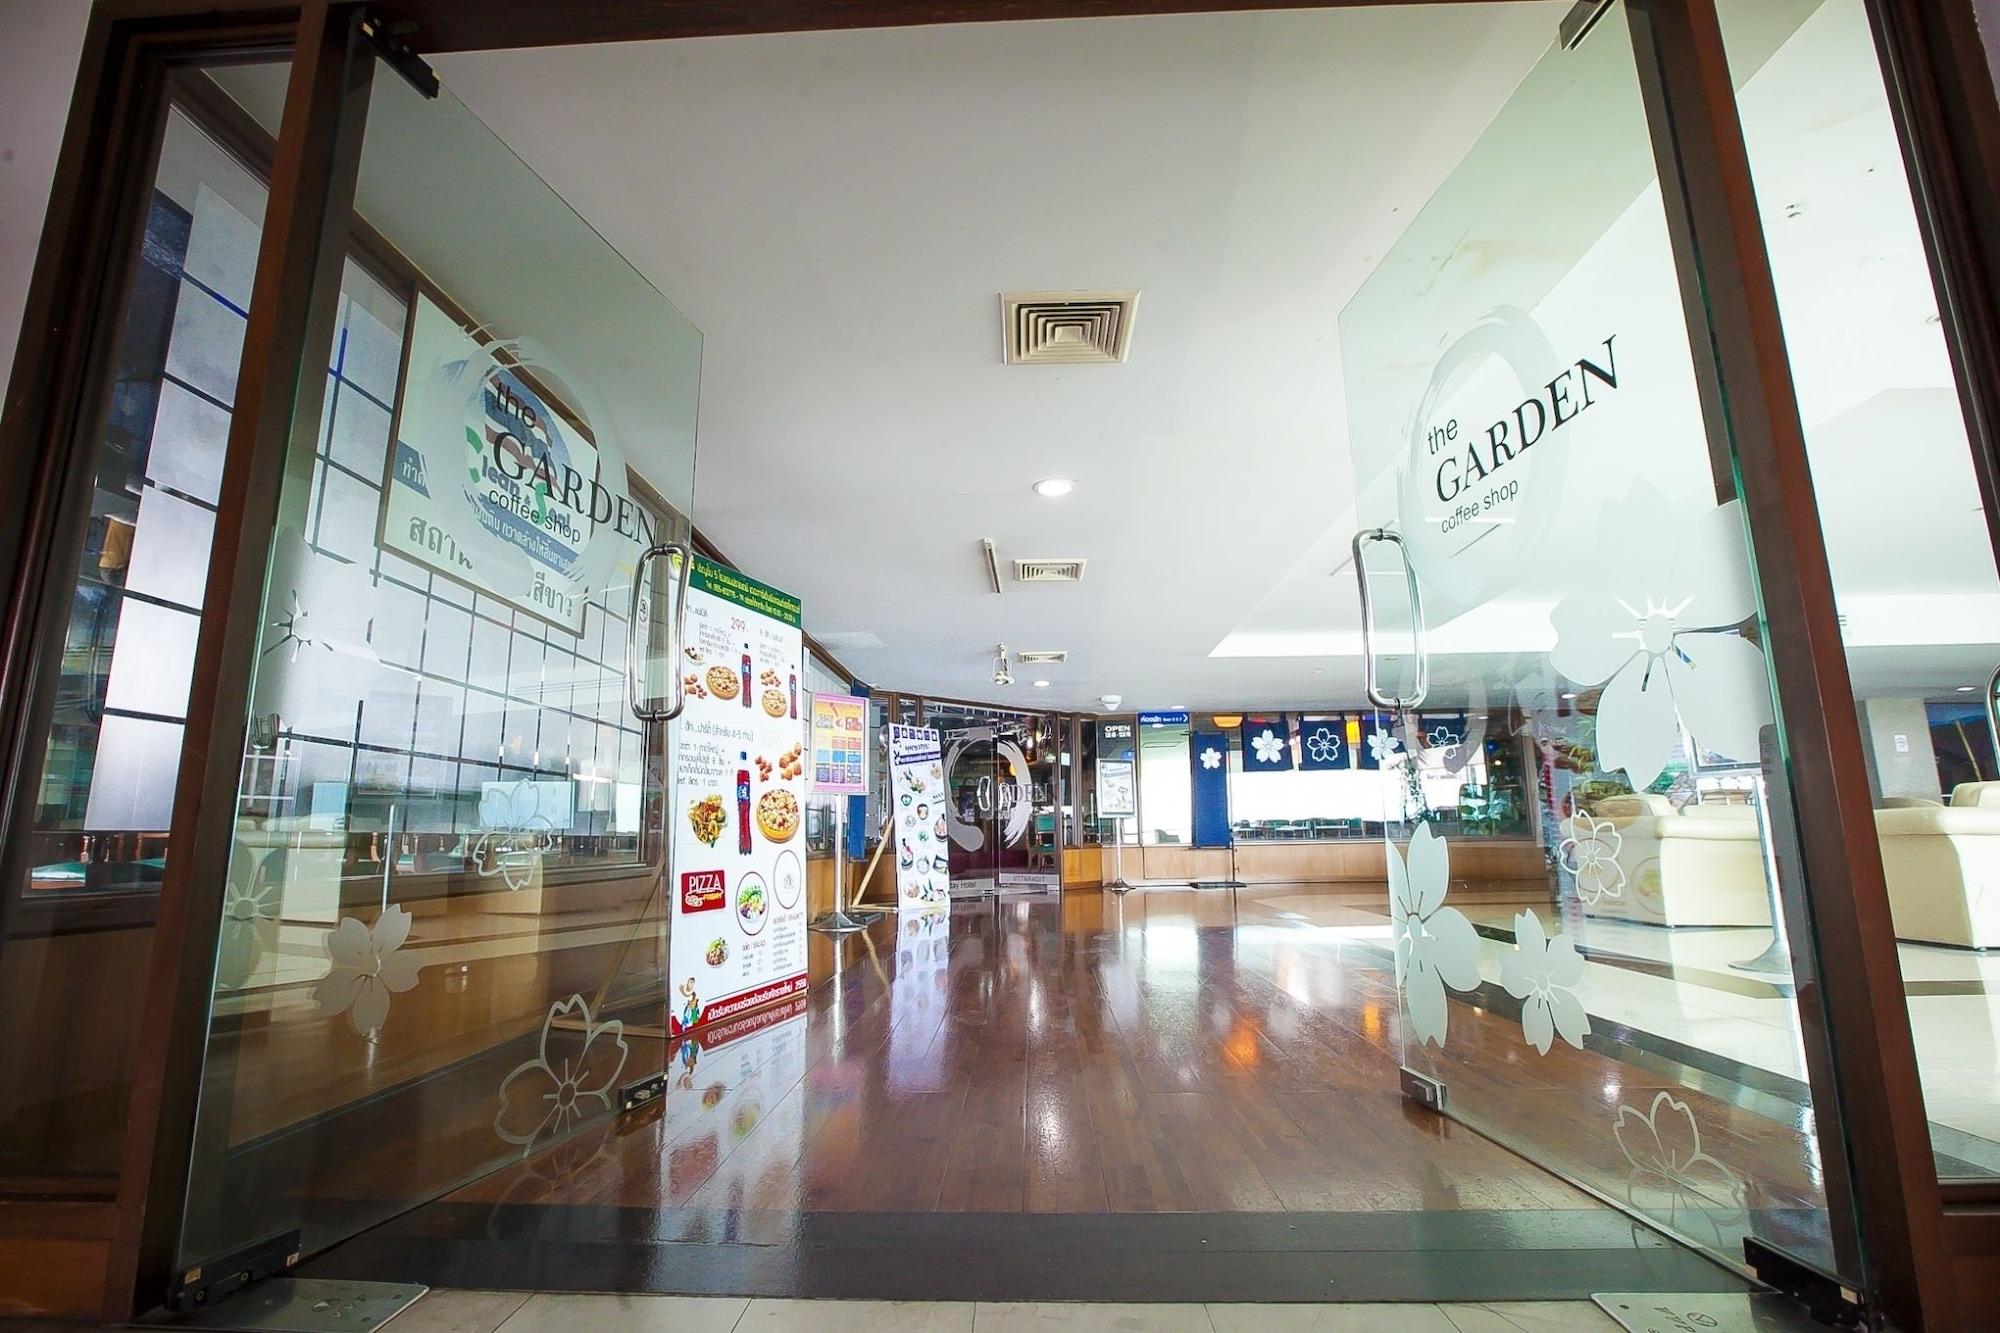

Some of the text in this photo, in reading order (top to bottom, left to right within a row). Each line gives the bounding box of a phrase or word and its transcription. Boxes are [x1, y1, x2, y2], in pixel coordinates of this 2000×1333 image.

[495, 382, 537, 429] the
[1436, 333, 1617, 503] GARDEN
[1427, 418, 1458, 455] the
[493, 431, 659, 548] GARDEN
[1441, 479, 1519, 534] coffee shop
[488, 490, 581, 545] coffee shop
[1104, 725, 1131, 733] OPEN
[689, 874, 721, 894] PIZZA
